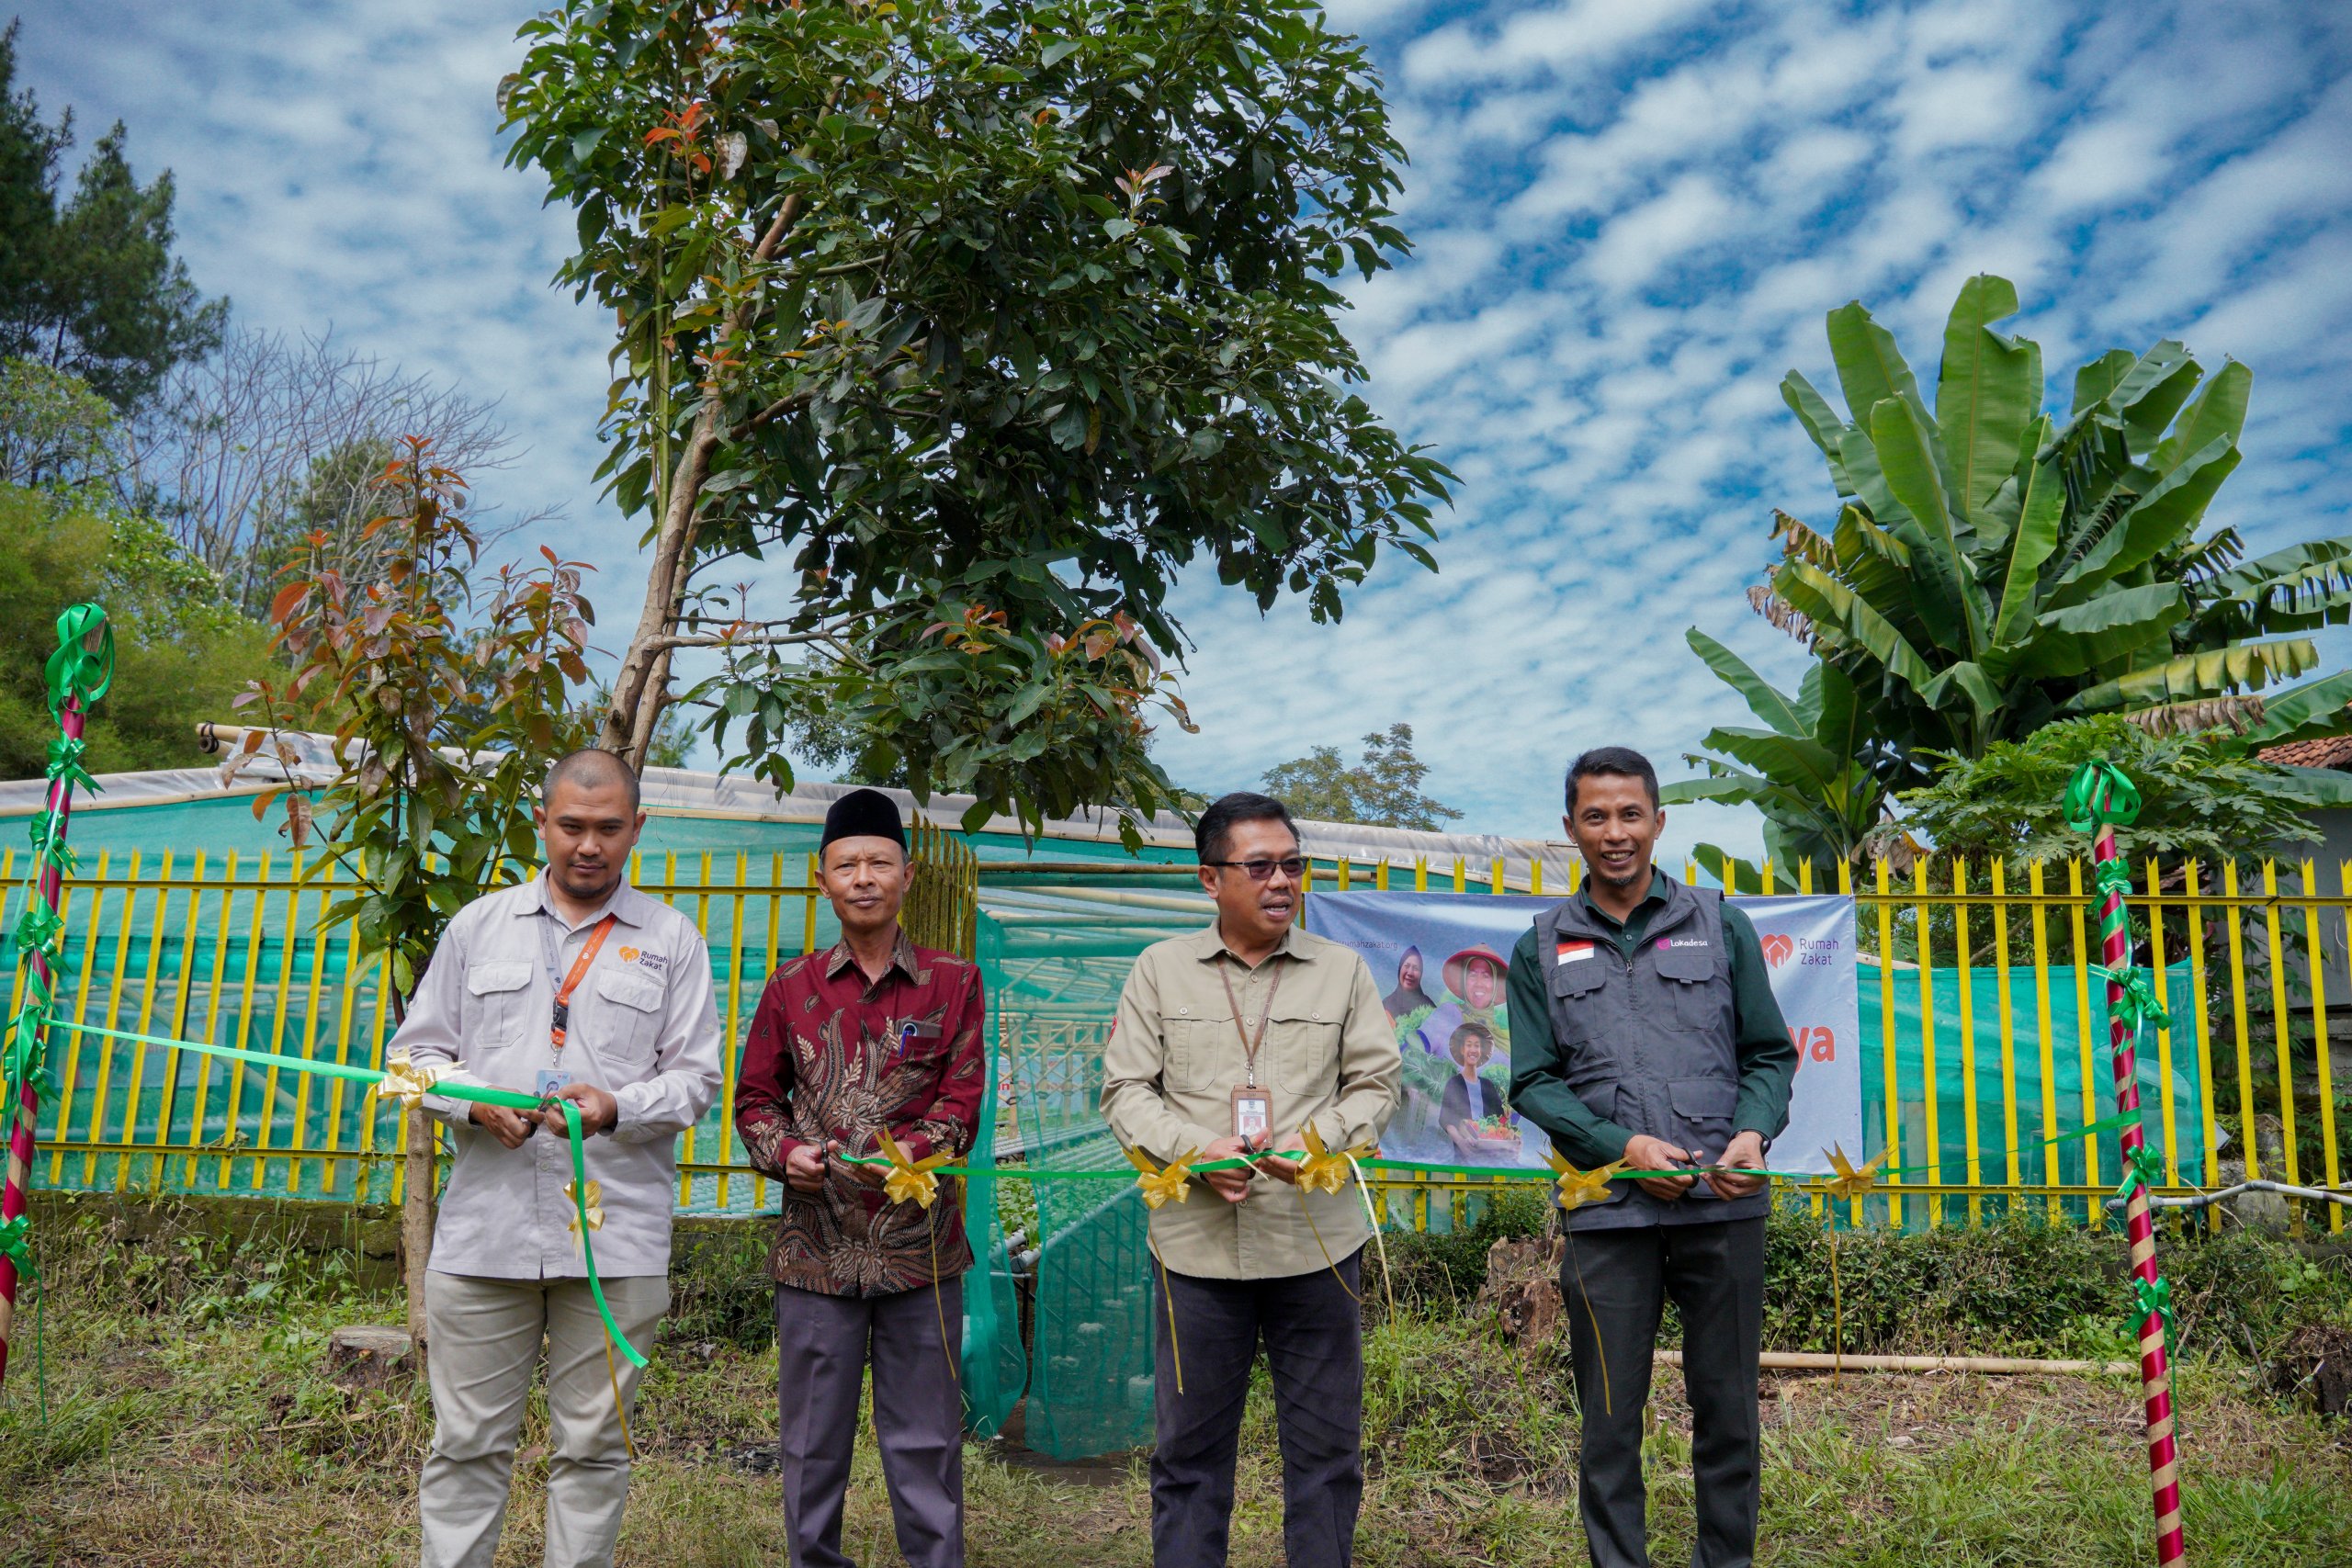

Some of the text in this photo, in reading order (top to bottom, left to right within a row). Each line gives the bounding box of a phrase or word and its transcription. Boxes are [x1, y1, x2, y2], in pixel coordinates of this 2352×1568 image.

[1670, 938, 1708, 947] Lokadesa
[1799, 938, 1839, 950] Rumah
[640, 950, 669, 964] Rumah
[1801, 953, 1832, 965] Zakat
[639, 957, 662, 971] Zakat
